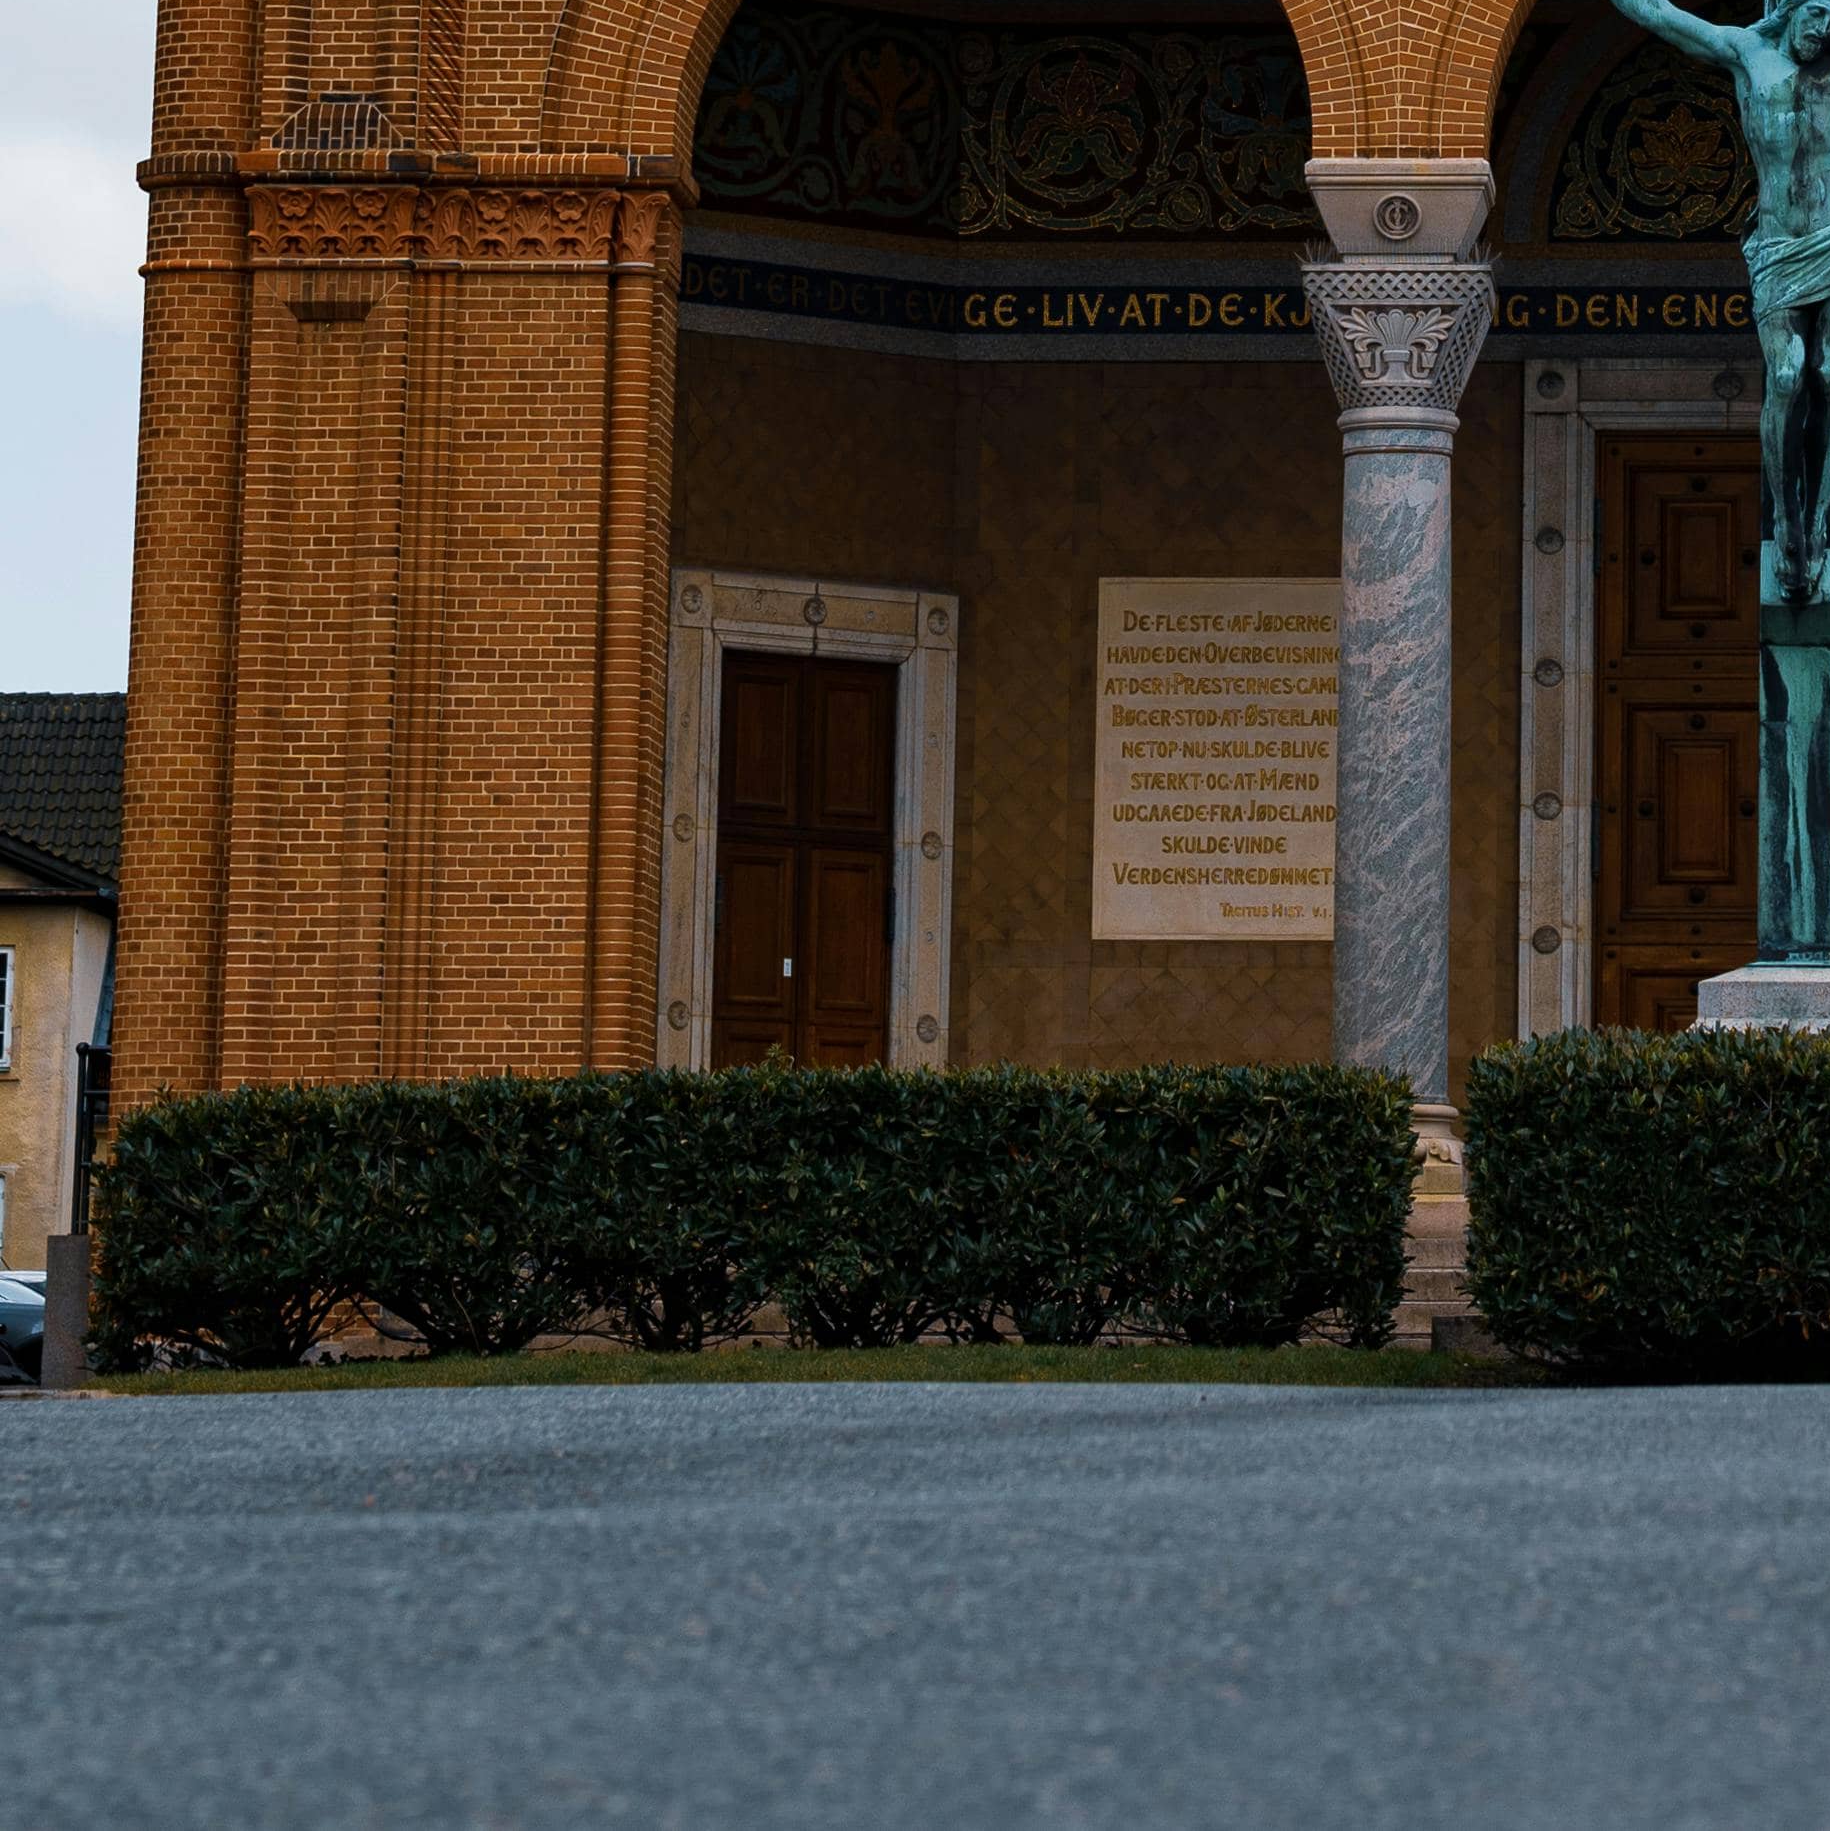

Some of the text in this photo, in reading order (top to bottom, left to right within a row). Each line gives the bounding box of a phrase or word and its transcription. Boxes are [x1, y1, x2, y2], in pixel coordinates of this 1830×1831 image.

[1043, 293, 1103, 328] LIV
[1120, 293, 1170, 328] AT
[1189, 293, 1244, 328] DE
[1556, 293, 1640, 329] DEN
[1156, 615, 1224, 632] FLESTE
[1107, 646, 1163, 664] HAVDE
[1166, 646, 1201, 664] DEN
[1104, 678, 1125, 695] AT
[1173, 672, 1293, 695] PRÆSTERNES
[1112, 704, 1171, 727] BØGER
[1175, 709, 1218, 727] STOD
[1220, 709, 1241, 727] AT
[1122, 740, 1330, 759] NETOP NU SKULDE BLIVE
[1131, 768, 1319, 791] STÆRKT OG AT MÆND
[1210, 804, 1243, 822] FRA
[1162, 836, 1287, 854] SKULDE VINDE
